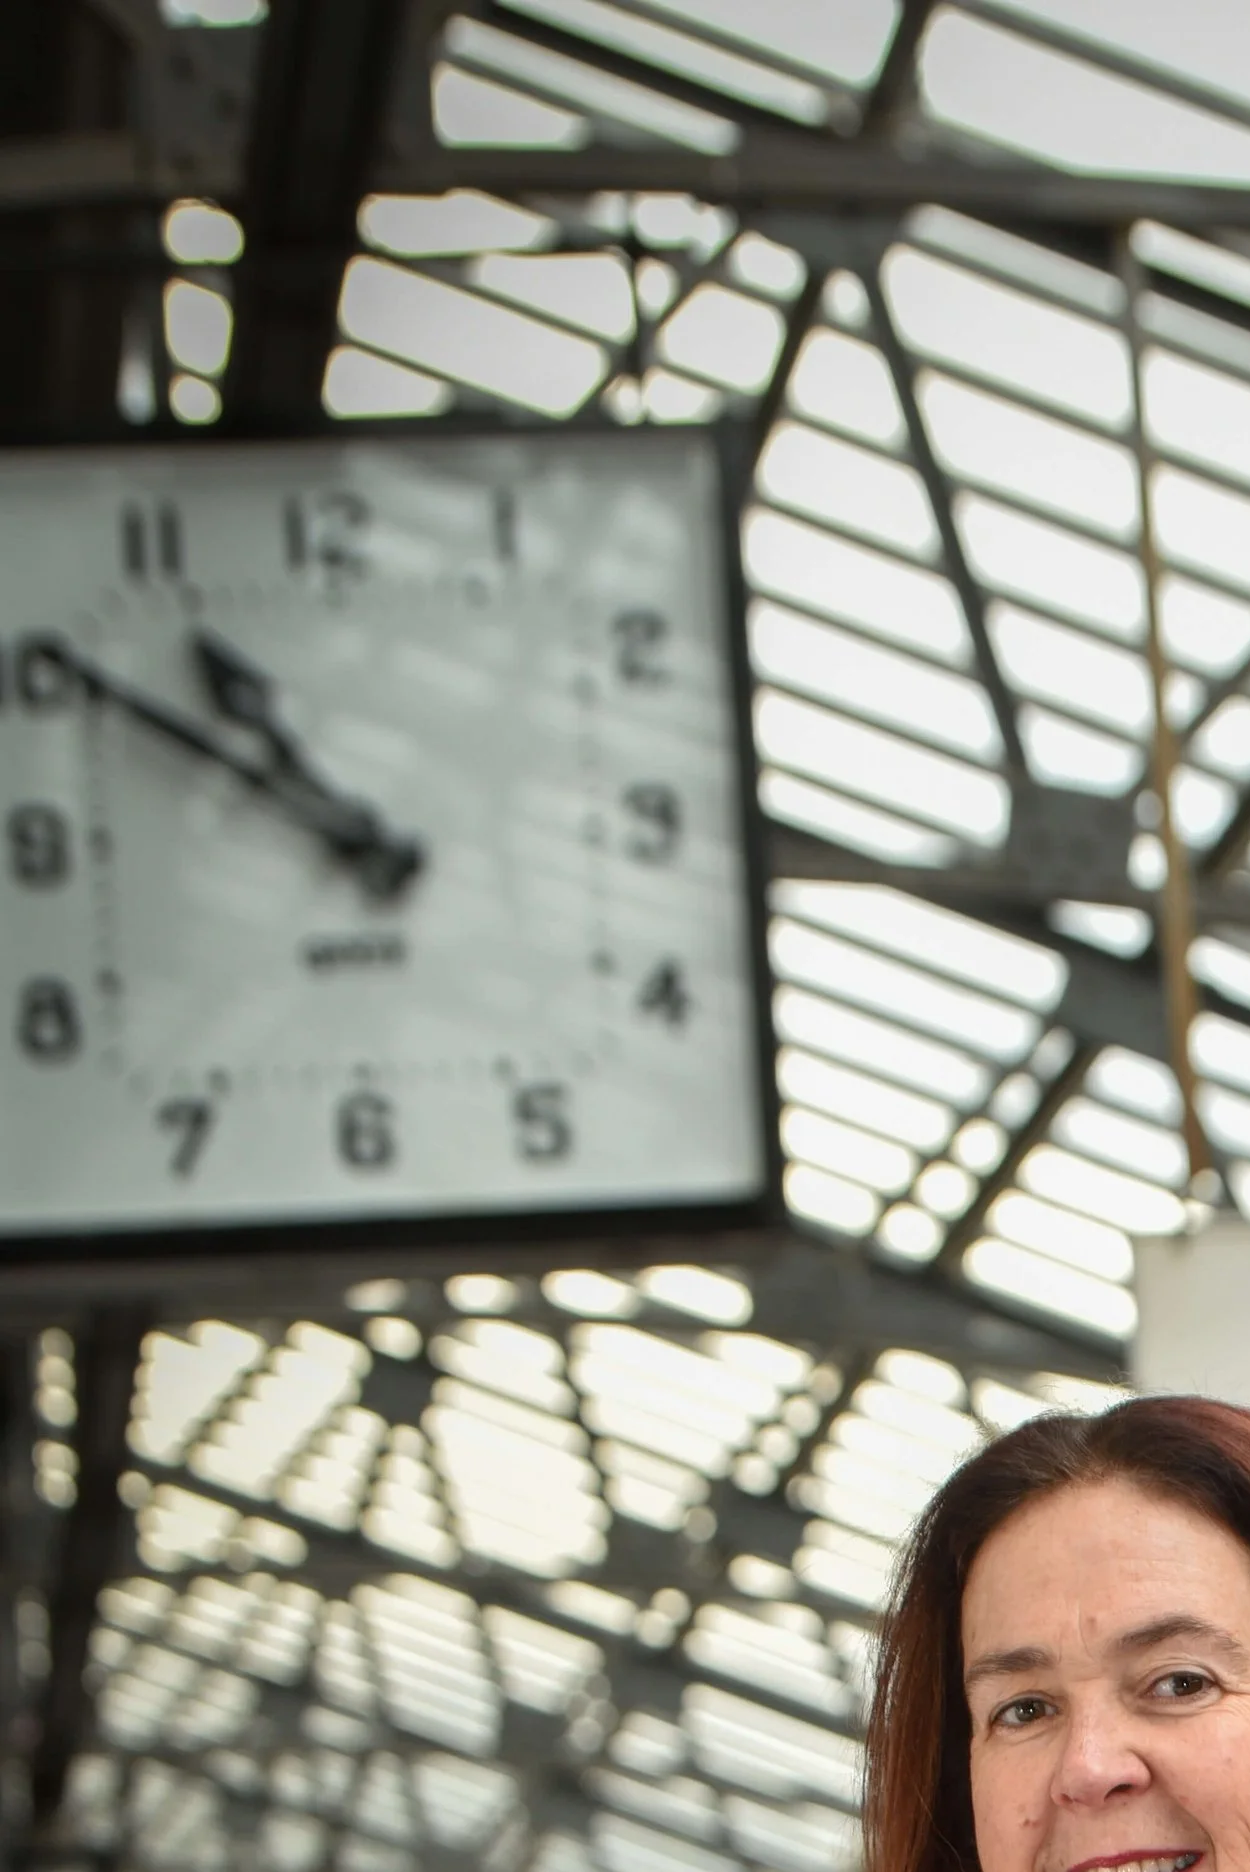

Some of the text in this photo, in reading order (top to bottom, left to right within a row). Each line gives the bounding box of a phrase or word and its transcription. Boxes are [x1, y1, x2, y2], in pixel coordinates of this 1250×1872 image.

[122, 497, 183, 581] 11
[284, 493, 371, 580] 12
[494, 487, 517, 563] 1
[613, 610, 671, 686] 2
[8, 803, 70, 889] 9
[624, 783, 680, 862] 3
[17, 978, 81, 1065] 8
[637, 958, 689, 1030] 4
[156, 1099, 212, 1180] 7
[335, 1094, 393, 1173] 6
[514, 1084, 573, 1163] 5
